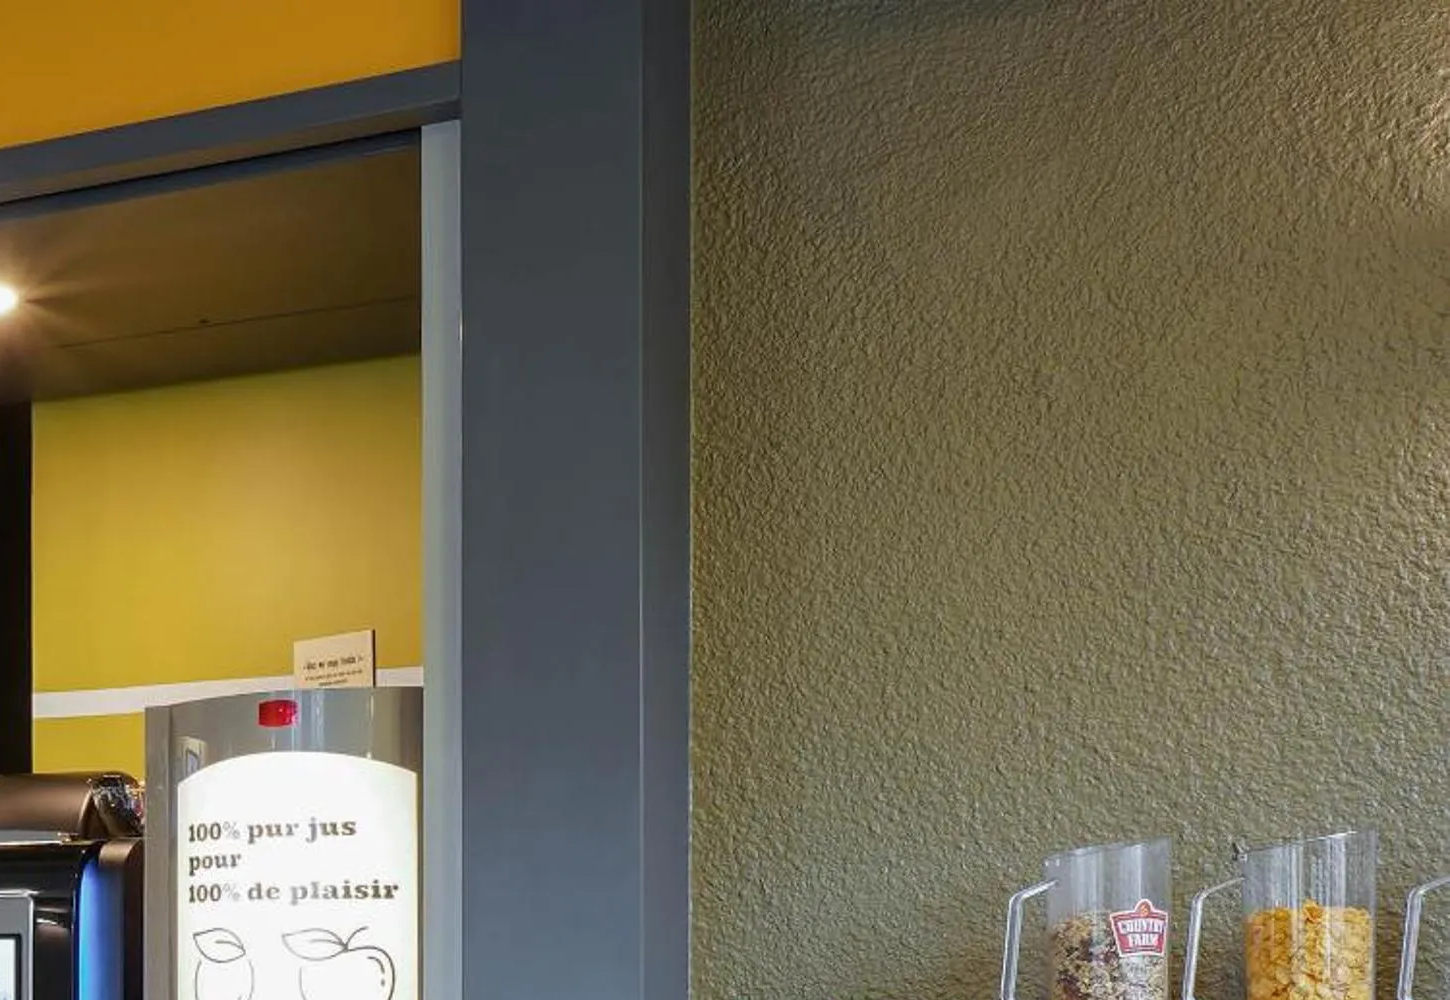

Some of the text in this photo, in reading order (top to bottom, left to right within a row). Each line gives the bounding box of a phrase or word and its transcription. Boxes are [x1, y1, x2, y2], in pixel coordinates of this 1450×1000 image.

[188, 817, 357, 844] 100% pur jus
[188, 853, 242, 876] pour
[188, 879, 399, 906] 100% de plaisir
[1128, 933, 1160, 947] FARM
